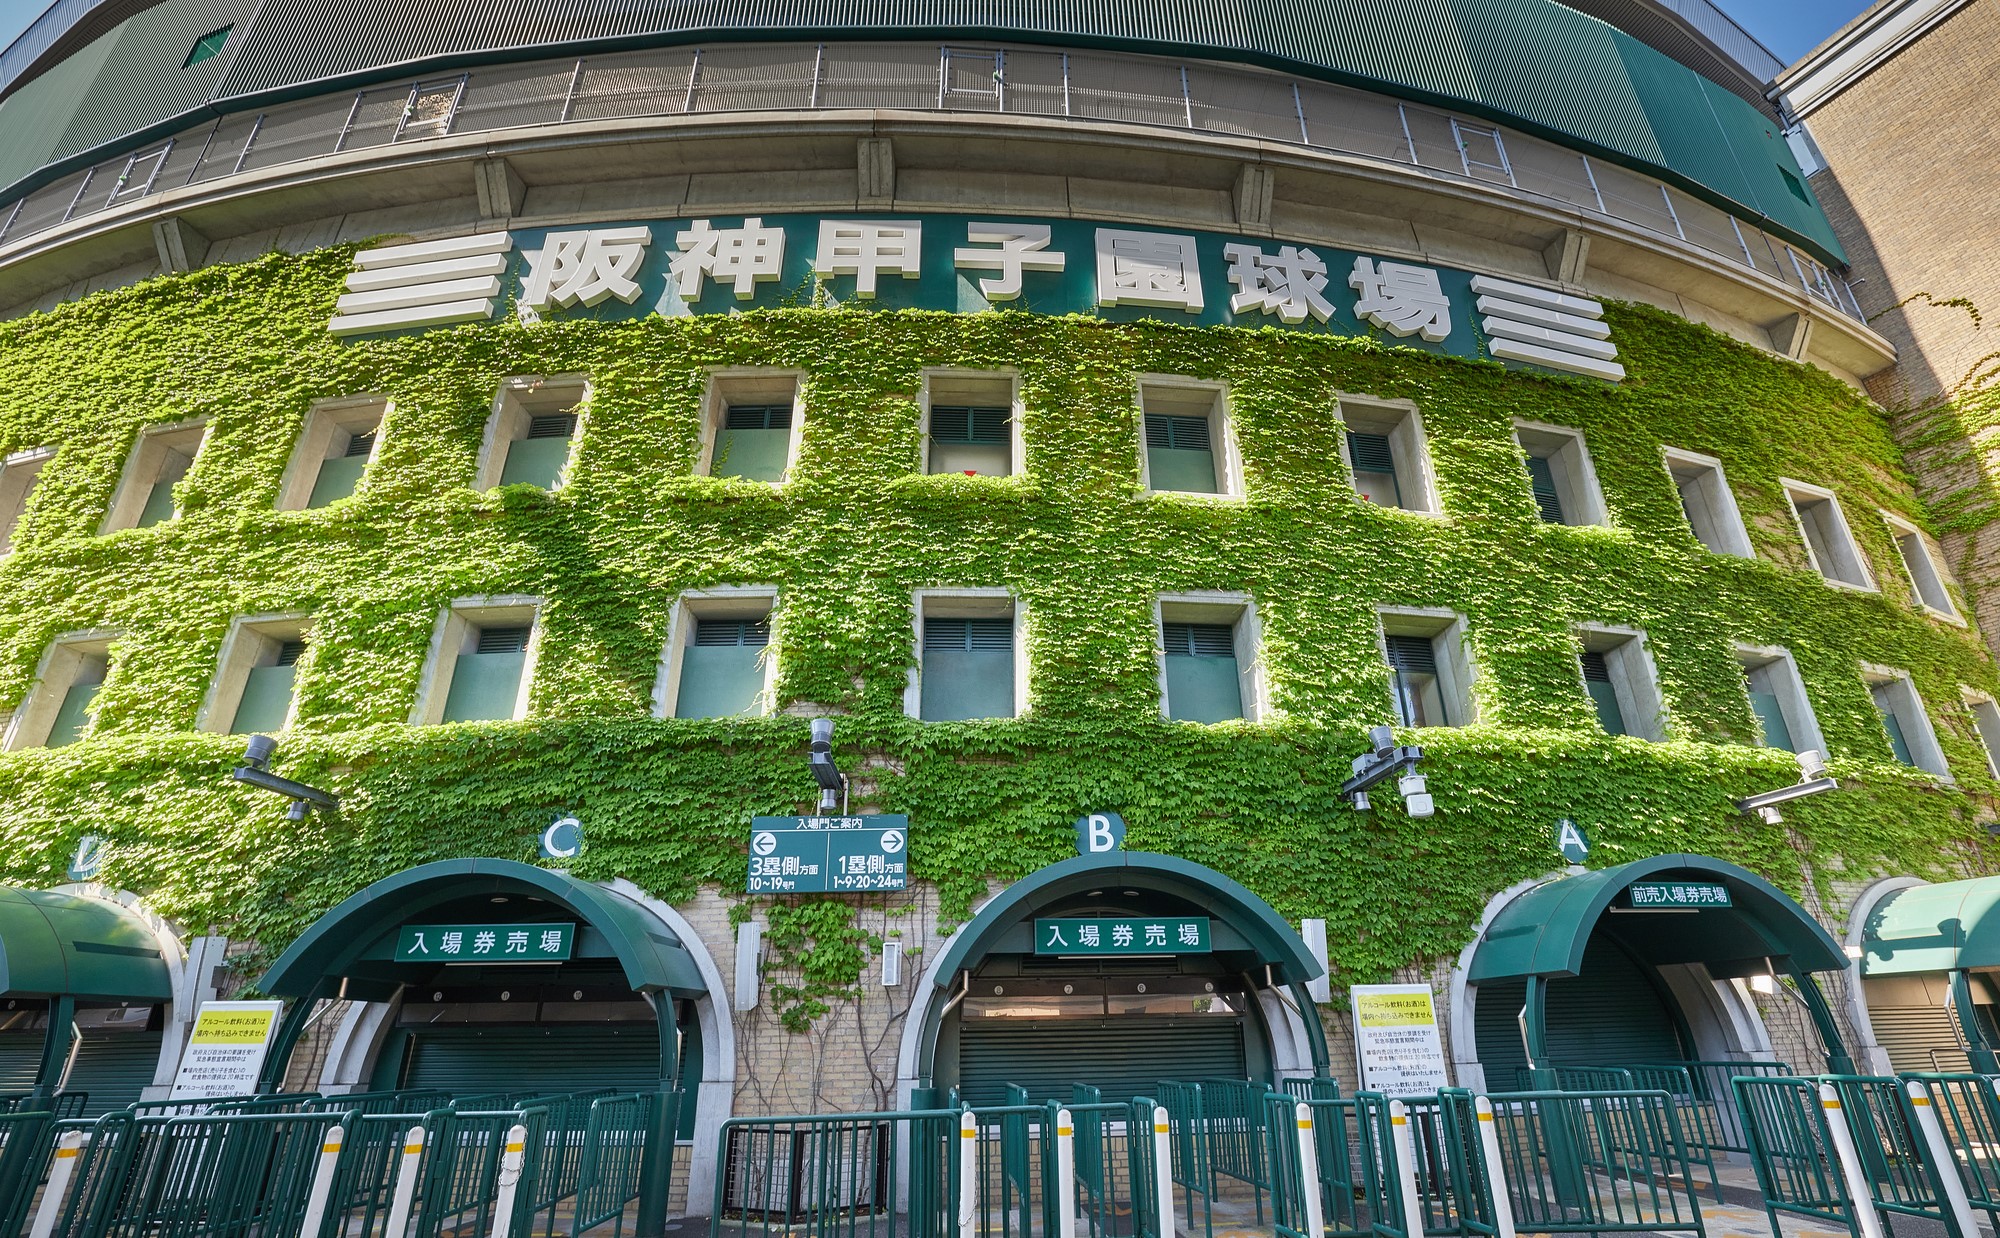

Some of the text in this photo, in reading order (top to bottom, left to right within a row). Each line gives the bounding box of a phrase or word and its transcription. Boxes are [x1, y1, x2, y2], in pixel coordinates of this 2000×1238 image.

[523, 216, 1453, 343] 阪神甲子園球場
[796, 817, 863, 830] 入場門ご案内
[1088, 814, 1115, 852] B
[544, 817, 580, 858] C
[1558, 819, 1589, 852] A
[750, 856, 819, 876] 3塁側方面
[838, 854, 904, 875] 1塁側方面
[1632, 886, 1728, 903] 前売入場券売場
[407, 930, 563, 954] 入場券売場
[1046, 924, 1200, 947] 入場券売場
